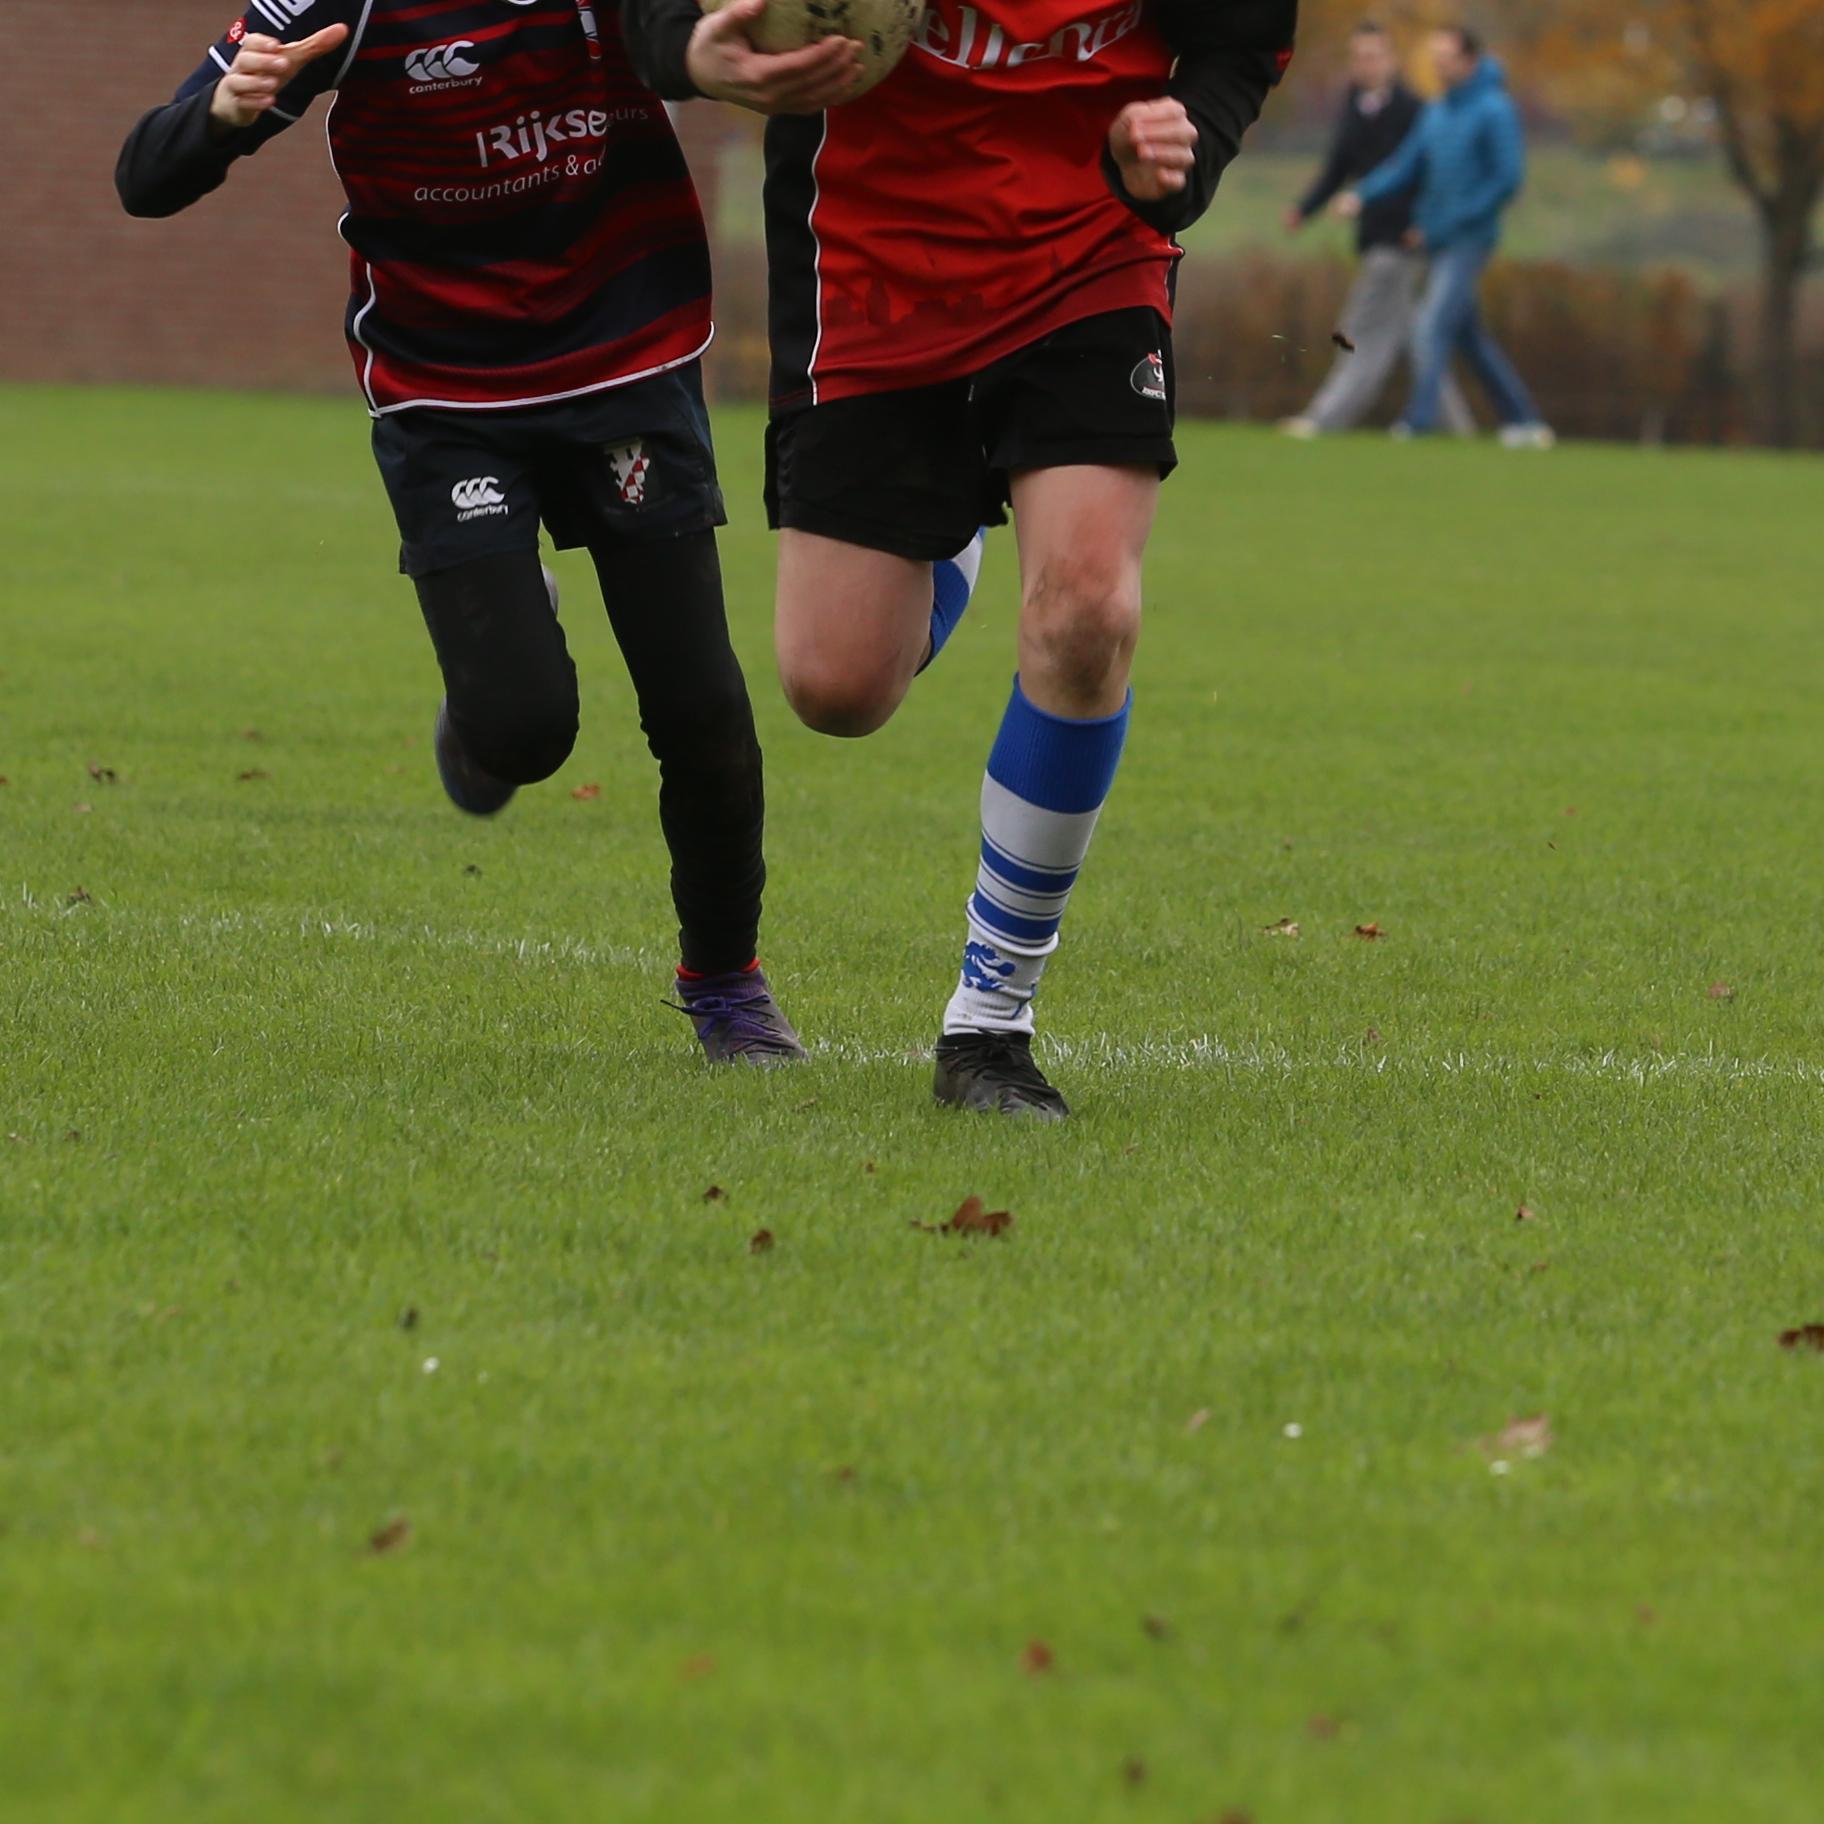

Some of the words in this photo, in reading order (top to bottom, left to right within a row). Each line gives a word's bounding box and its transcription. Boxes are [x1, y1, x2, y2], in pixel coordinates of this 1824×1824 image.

[408, 76, 483, 94] canterbury
[414, 164, 560, 203] accountants
[565, 154, 580, 177] &
